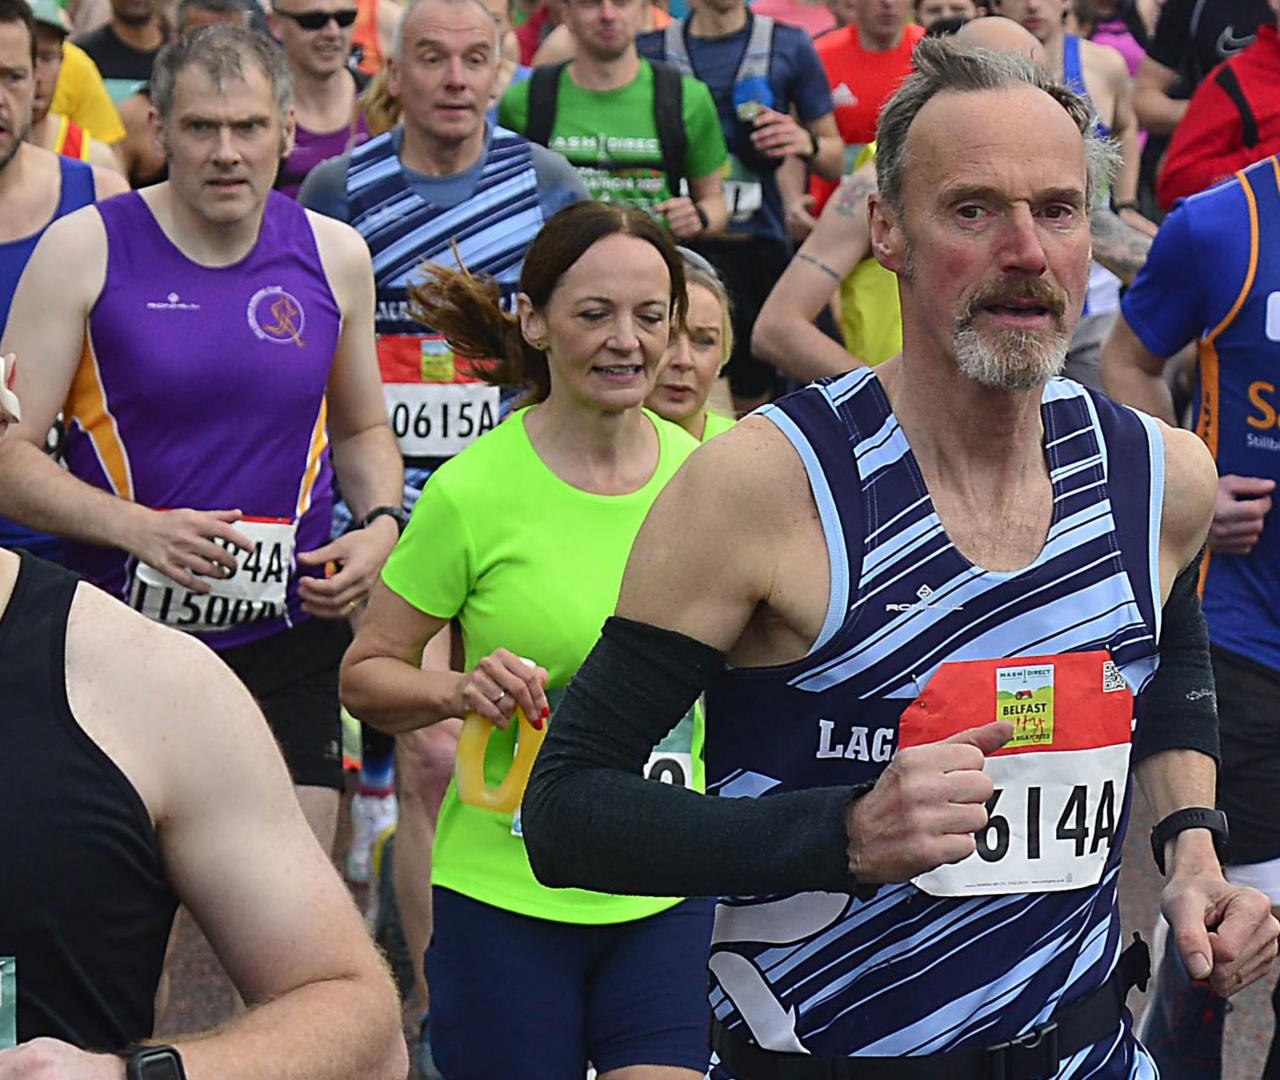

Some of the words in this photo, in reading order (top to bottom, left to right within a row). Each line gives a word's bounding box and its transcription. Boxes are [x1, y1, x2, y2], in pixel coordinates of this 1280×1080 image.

[1027, 669, 1051, 677] DIRECT
[1003, 703, 1048, 716] BELFAST
[816, 719, 895, 763] LAG
